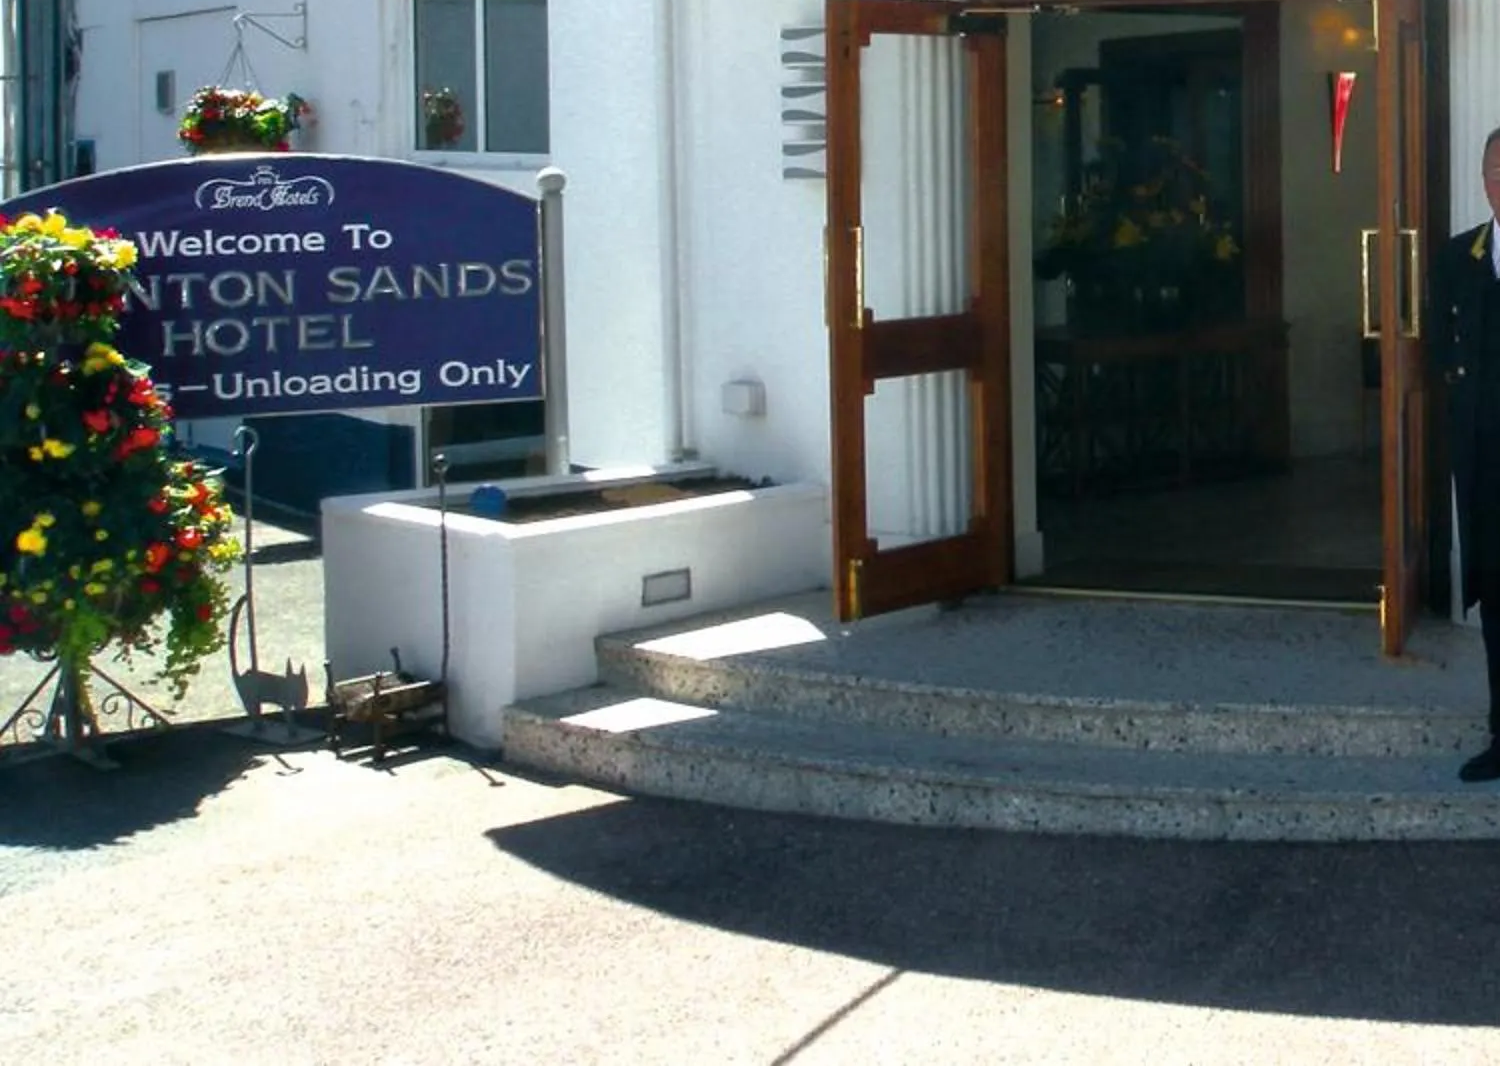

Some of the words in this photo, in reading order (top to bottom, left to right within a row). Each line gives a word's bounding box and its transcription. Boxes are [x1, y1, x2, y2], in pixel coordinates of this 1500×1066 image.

[261, 185, 319, 210] Hotels
[138, 230, 325, 258] Welcome
[343, 224, 392, 250] To
[123, 270, 296, 311] NTON
[327, 260, 533, 303] SANDS
[162, 314, 374, 357] HOTEL
[440, 359, 531, 389] Only
